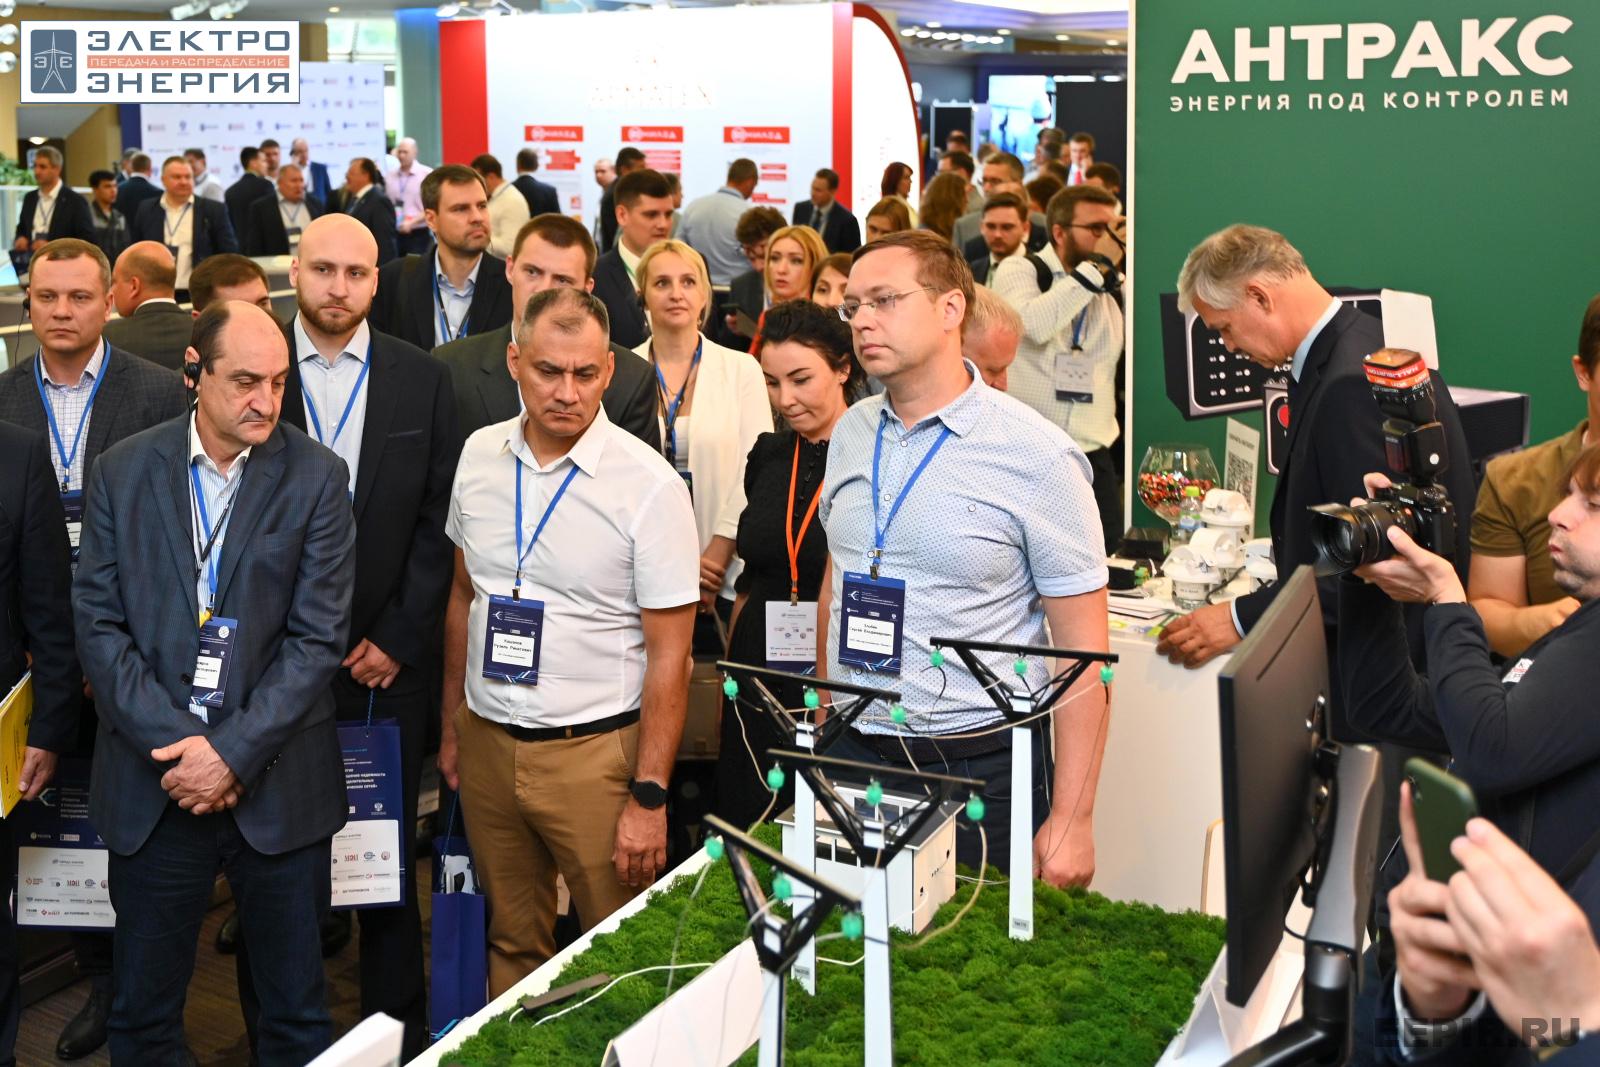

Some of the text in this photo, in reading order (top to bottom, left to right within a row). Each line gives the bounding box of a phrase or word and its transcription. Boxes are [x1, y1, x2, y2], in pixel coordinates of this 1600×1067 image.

[1171, 14, 1574, 84] АНТРАКС
[1169, 89, 1569, 112] ЭНЕРГИЯ ПОД КОНТРОЛЕМ
